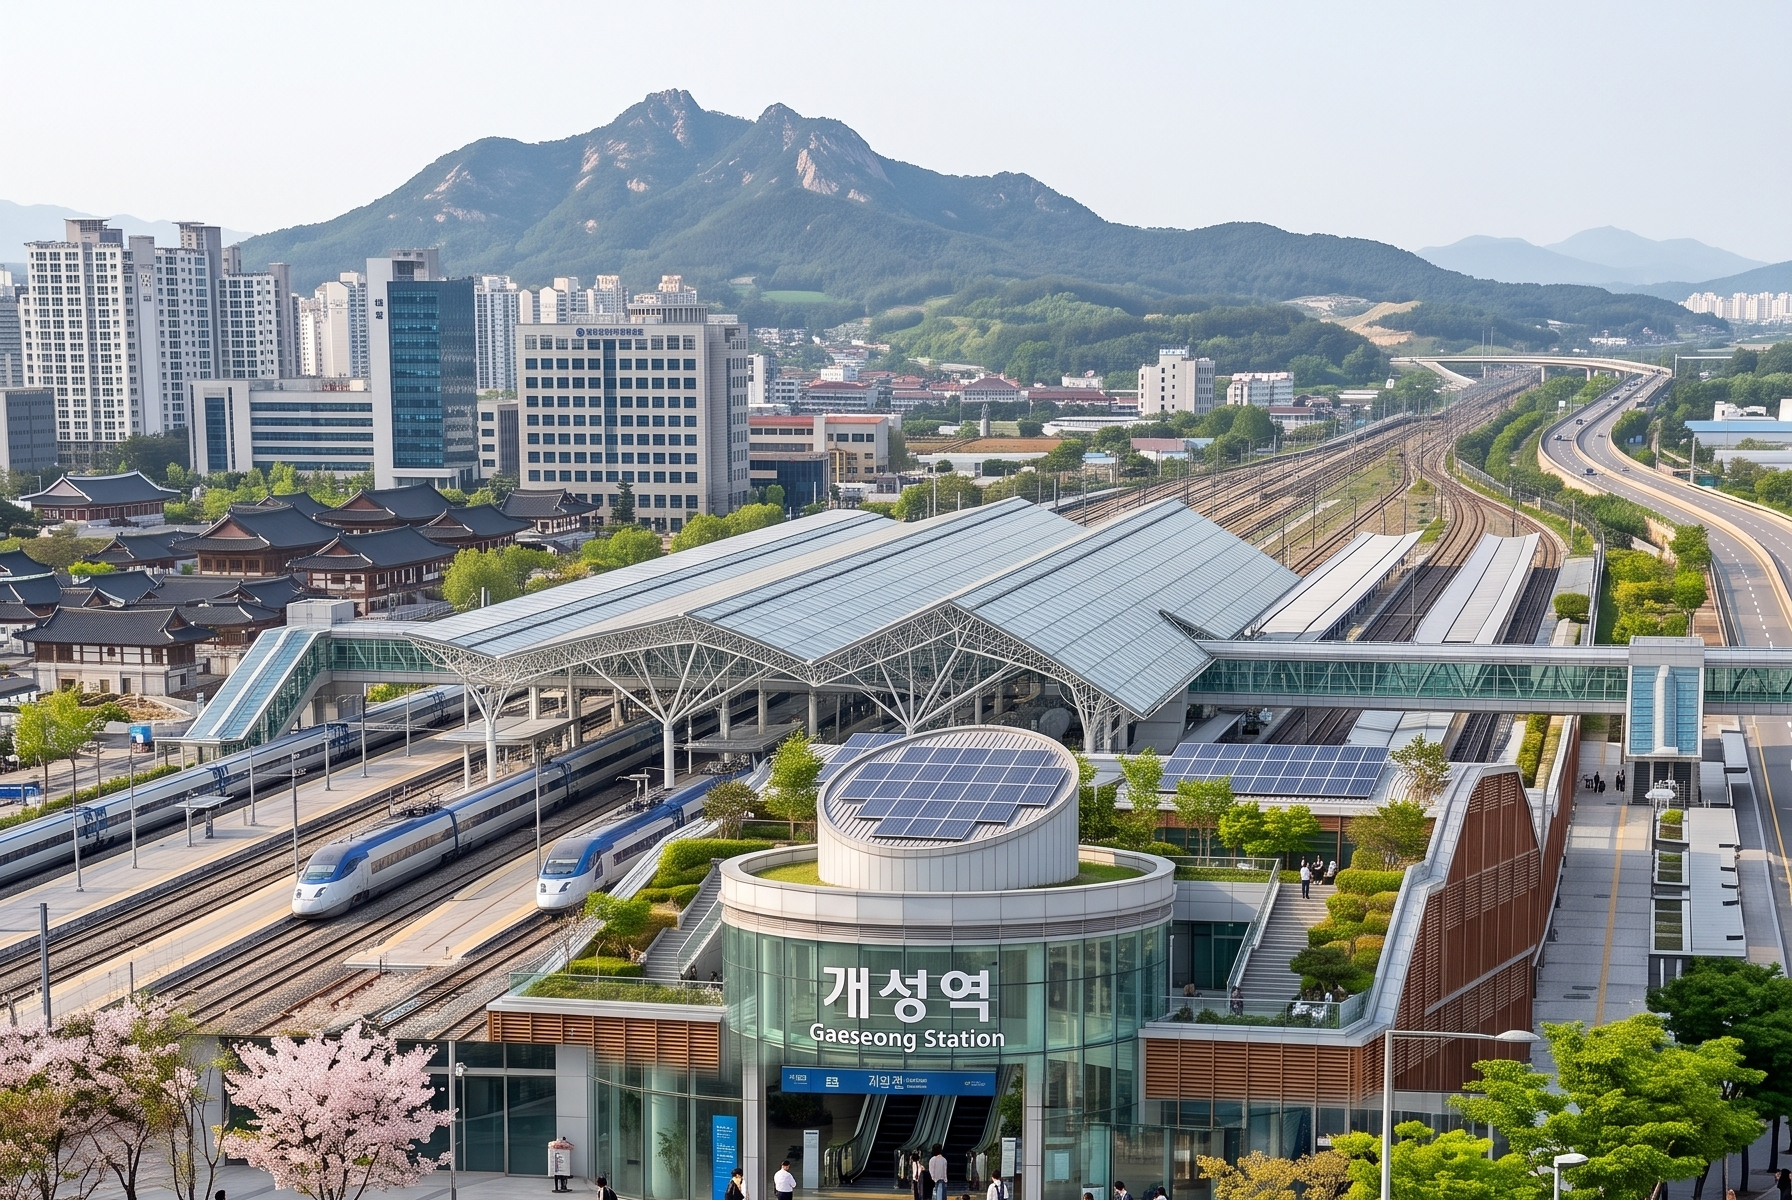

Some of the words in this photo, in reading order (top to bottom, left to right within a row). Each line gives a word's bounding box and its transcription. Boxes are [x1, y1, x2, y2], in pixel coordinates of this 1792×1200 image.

[823, 966, 990, 1023] 개성역
[809, 1022, 917, 1053] Gaeseong
[924, 1029, 1005, 1048] Station
